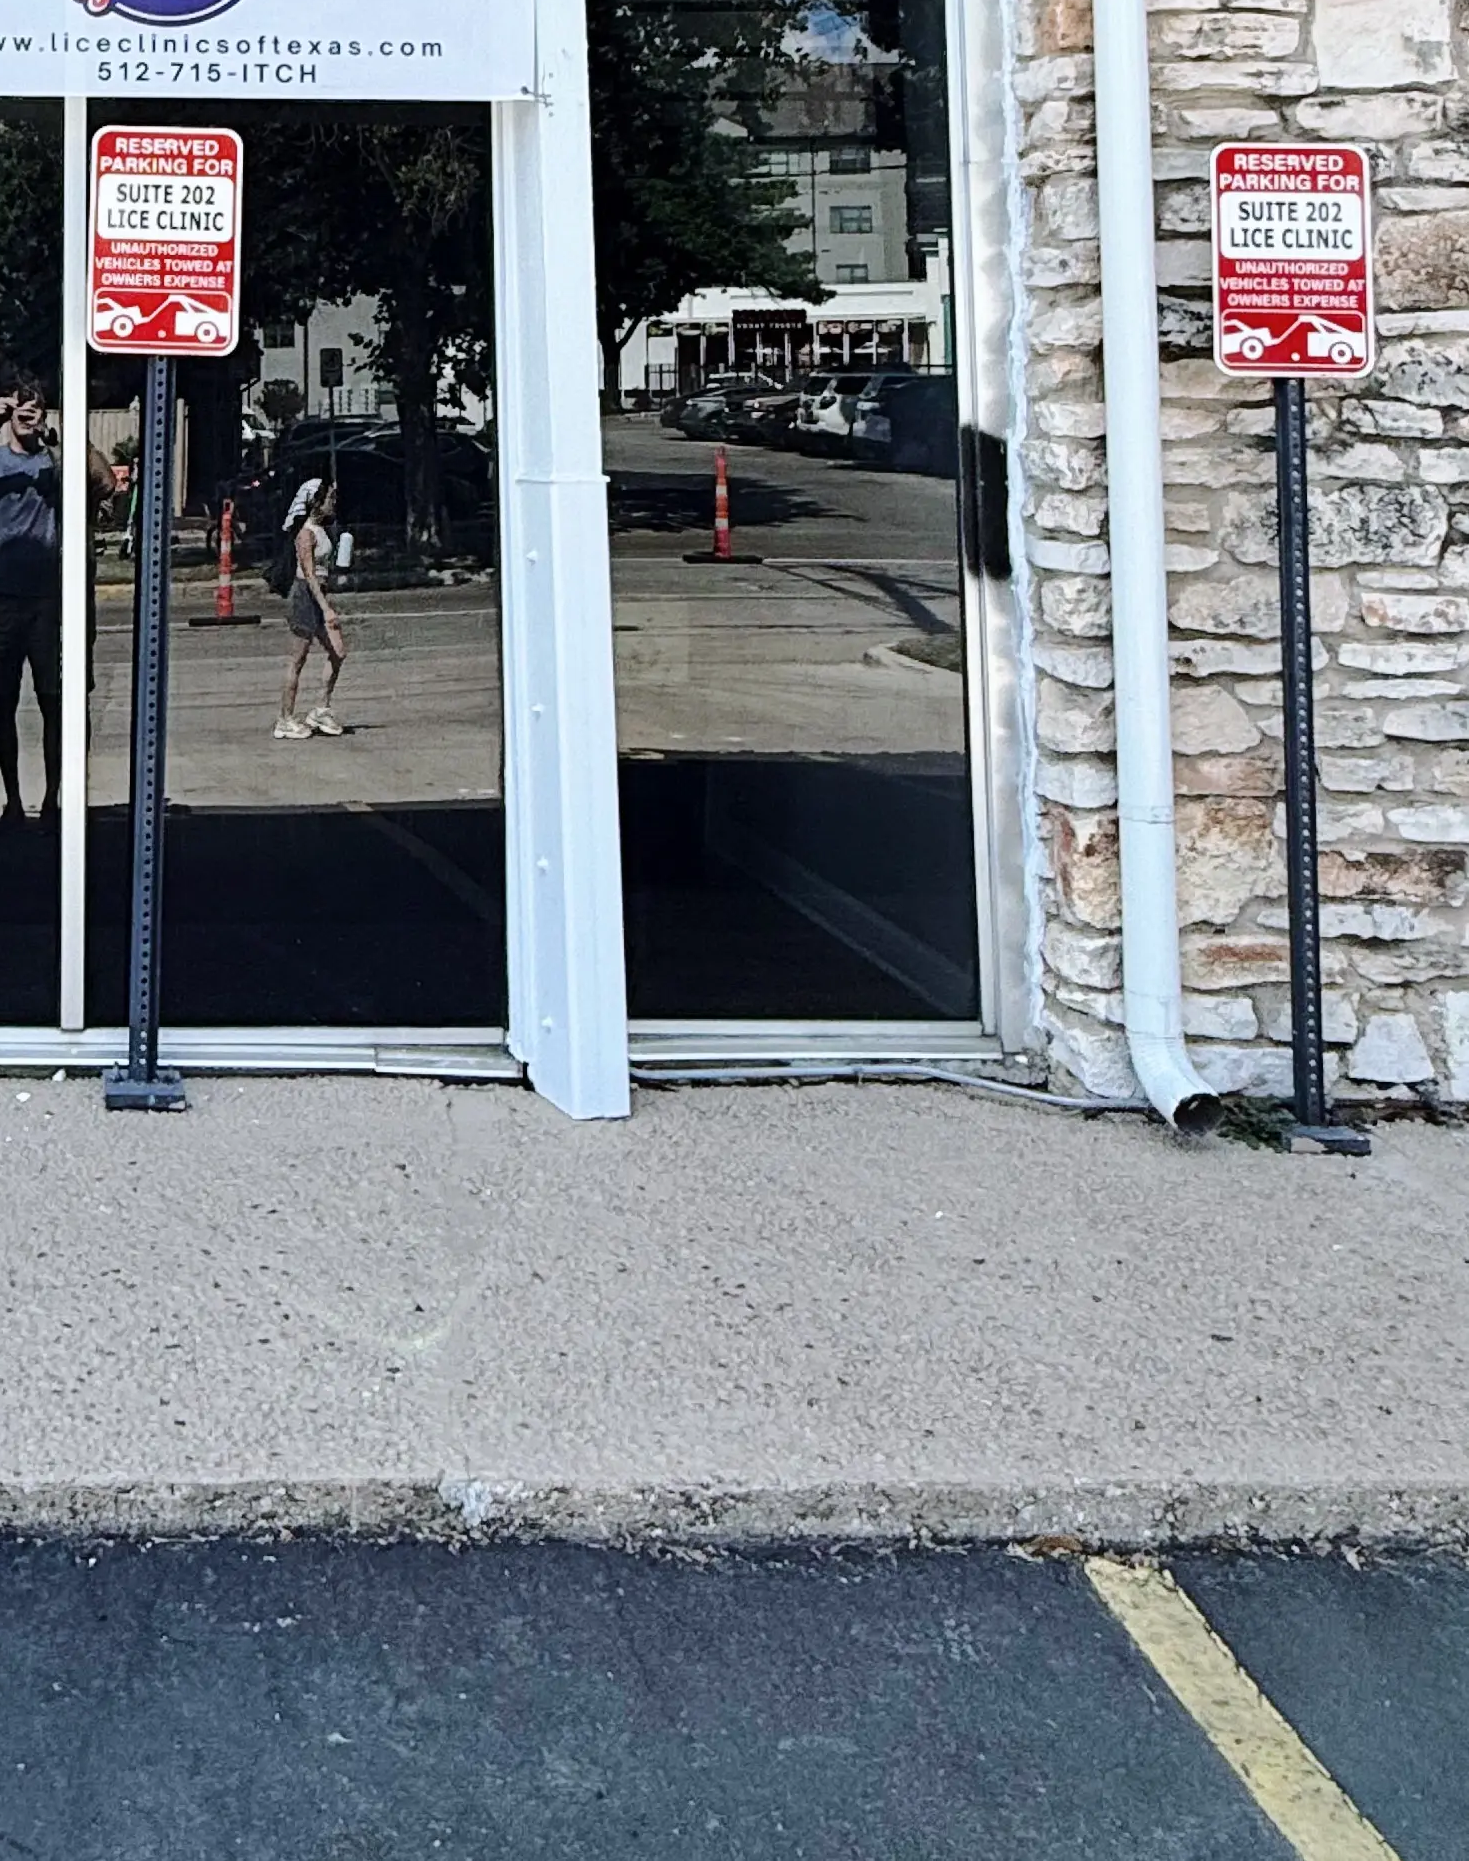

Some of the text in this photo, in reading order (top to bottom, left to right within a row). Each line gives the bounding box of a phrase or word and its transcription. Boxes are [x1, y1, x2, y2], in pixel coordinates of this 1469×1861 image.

[97, 61, 318, 83] 512-715-ITCH
[115, 137, 219, 156] RESERVED
[100, 156, 233, 175] PARKING FOR
[1234, 153, 1344, 172] RESERVED
[1219, 174, 1360, 191] PARKING FOR
[116, 183, 215, 206] SUITE 202
[107, 208, 224, 232] LICE CLINIC
[1238, 201, 1342, 222] SUITE 202
[1230, 227, 1353, 249] LICE CLINIC
[110, 242, 219, 257] UNAUTHORIZED
[95, 257, 233, 273] VEHICLES TOWED AT
[1235, 260, 1349, 276] UNAUTHORIZED
[101, 272, 226, 288] OWNERS EXPENSE
[1219, 276, 1365, 292] VEHICLES TOWED AT
[1227, 292, 1359, 309] OWNERS EXPENSE
